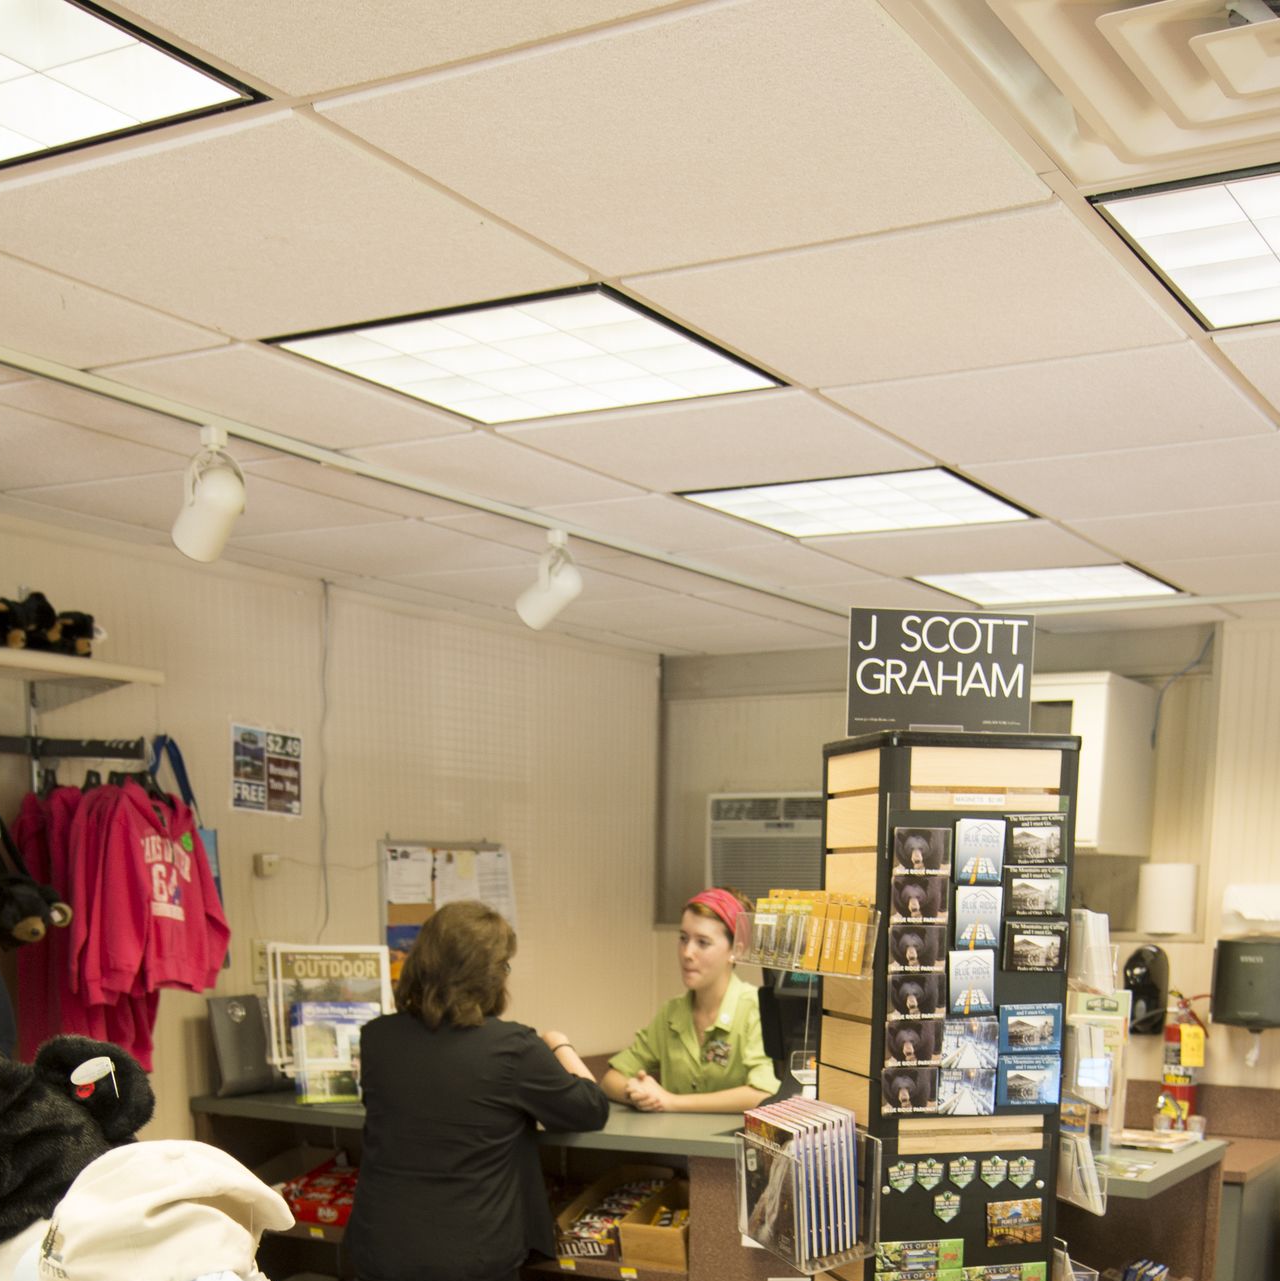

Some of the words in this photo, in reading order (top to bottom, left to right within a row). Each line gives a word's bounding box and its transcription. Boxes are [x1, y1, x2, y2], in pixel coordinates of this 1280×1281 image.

[858, 614, 877, 651] J
[900, 615, 1029, 655] SCOTT
[855, 658, 1024, 698] GRAHAM
[266, 732, 301, 759] $2.49
[233, 780, 266, 802] FREE
[294, 959, 377, 978] OUTDOOR
